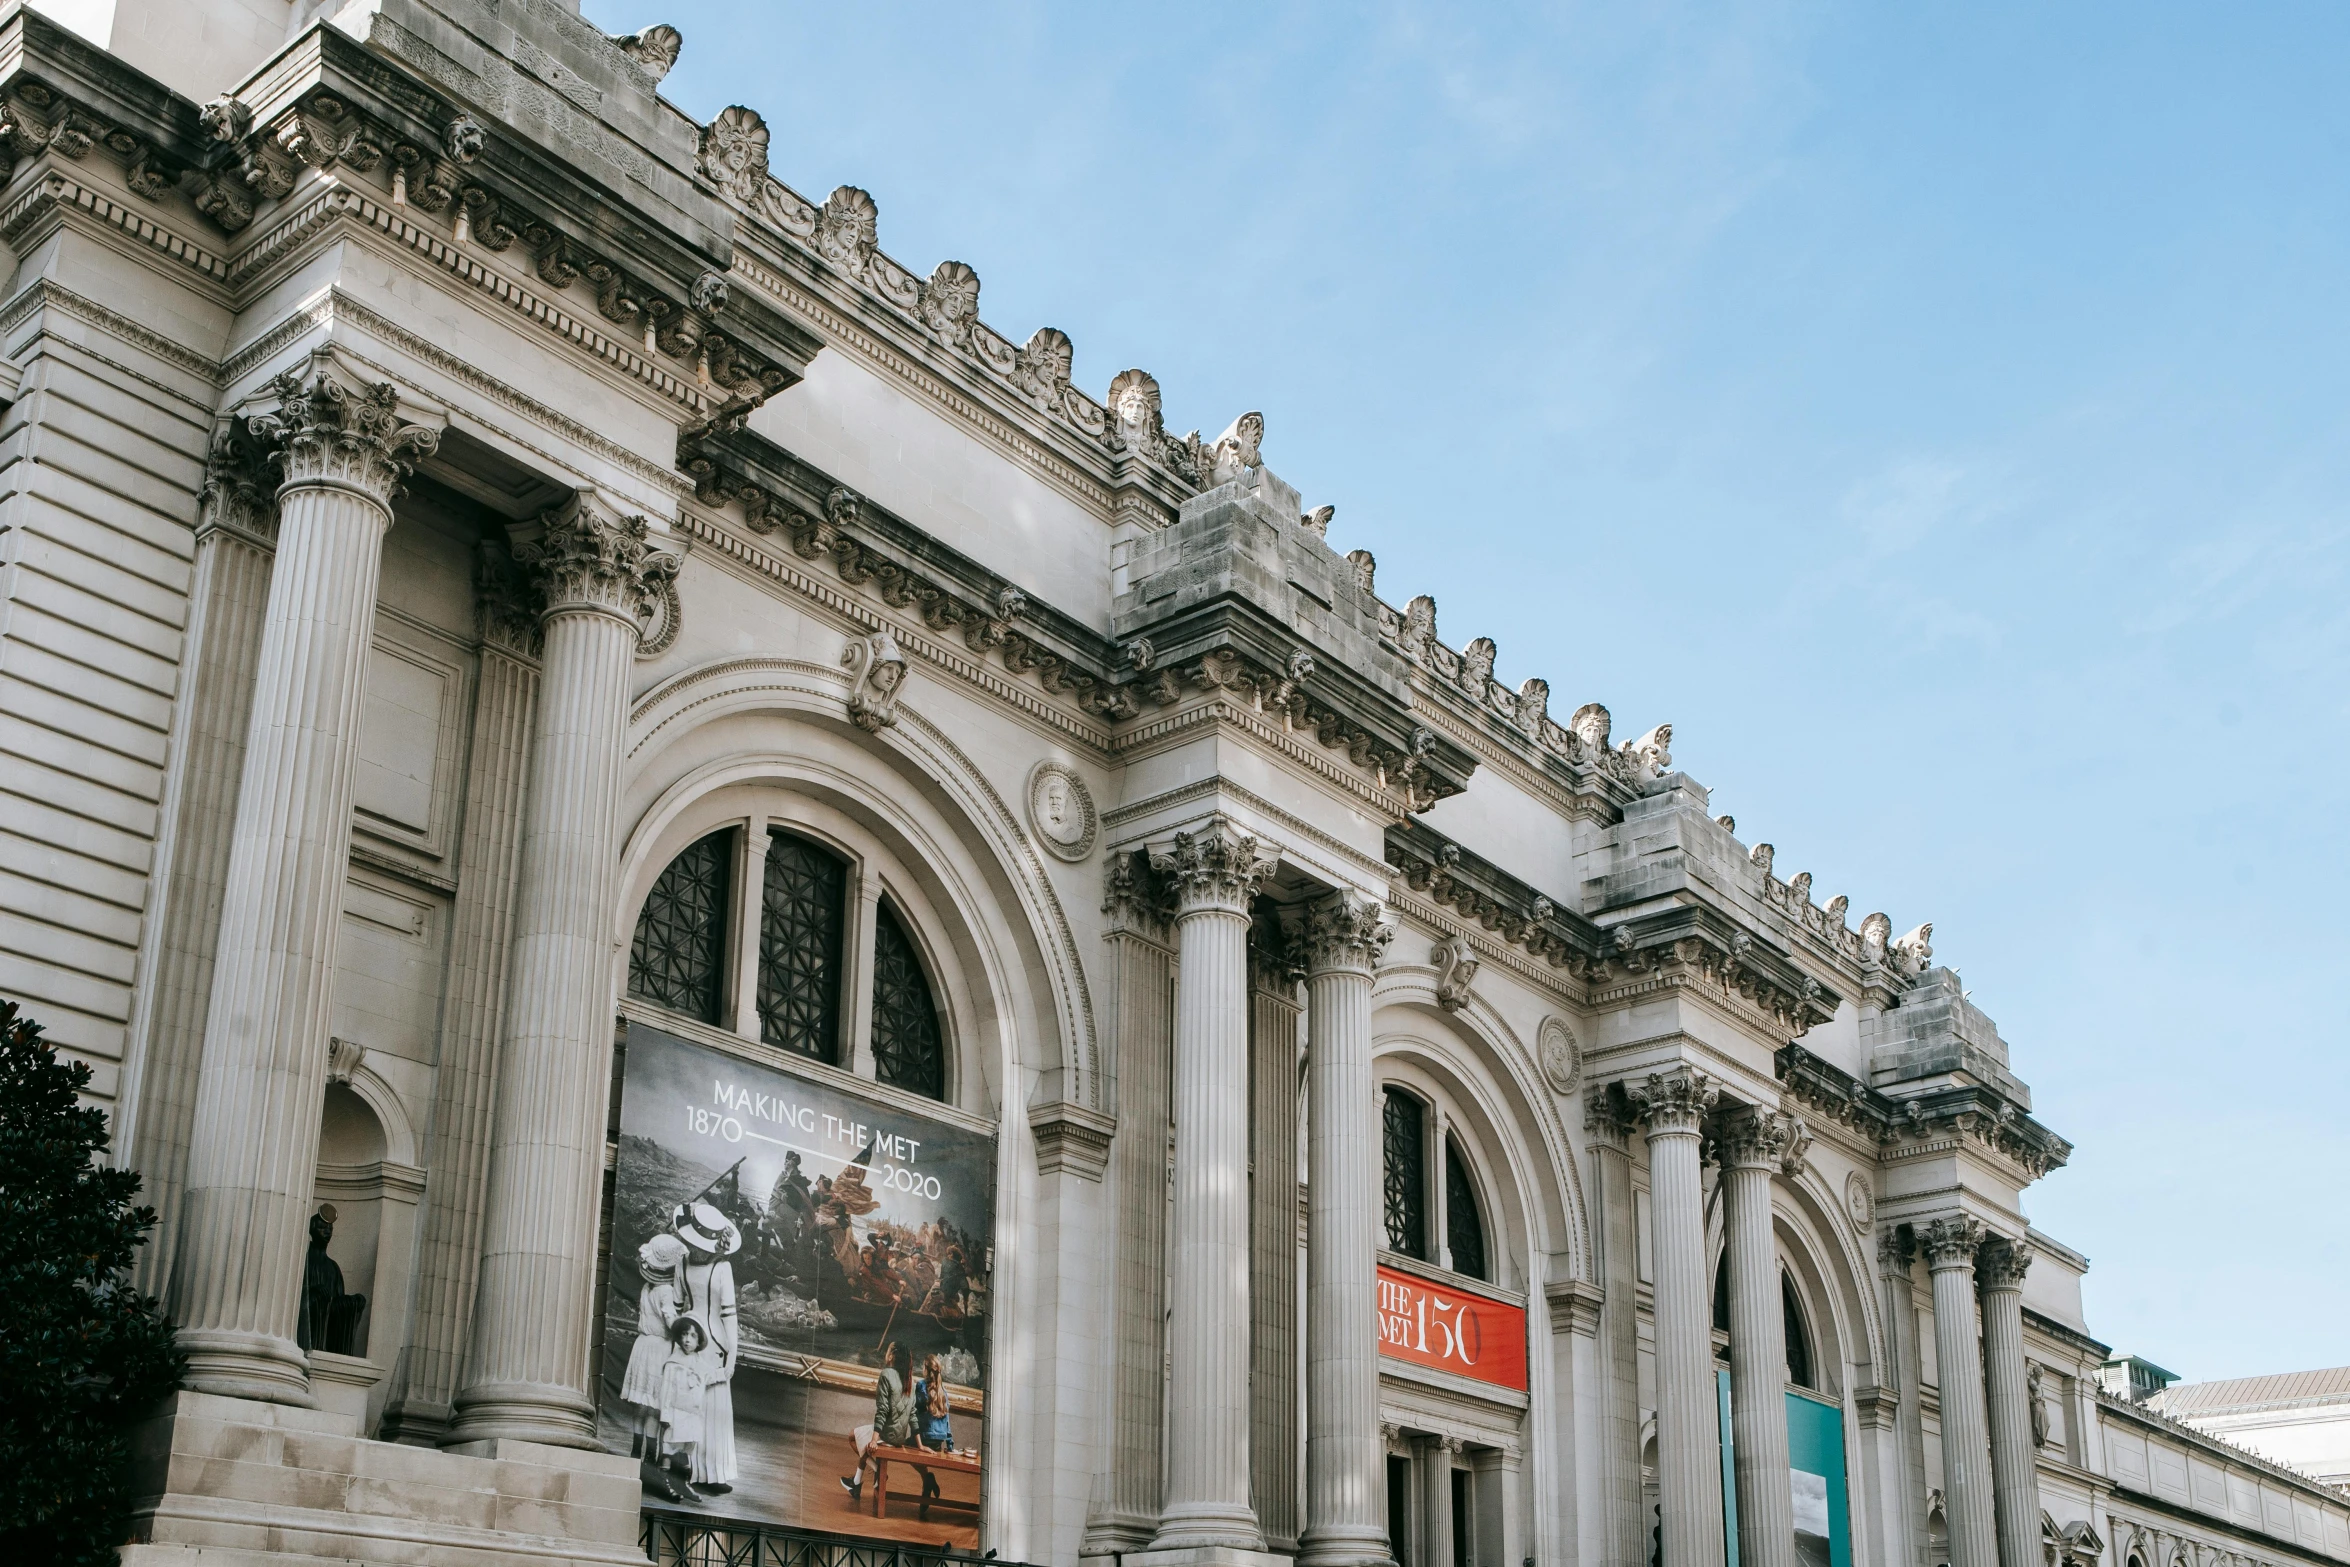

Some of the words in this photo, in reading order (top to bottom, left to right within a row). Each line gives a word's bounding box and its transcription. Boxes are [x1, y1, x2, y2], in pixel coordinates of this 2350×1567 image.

[687, 1105, 742, 1143] 1870
[883, 1163, 941, 1201] 2020
[714, 1080, 815, 1132] MAKING
[822, 1113, 867, 1149] THE
[876, 1129, 920, 1163] MET
[1377, 1279, 1412, 1316] THE
[1377, 1311, 1412, 1348] MET
[1414, 1293, 1481, 1365] 150
